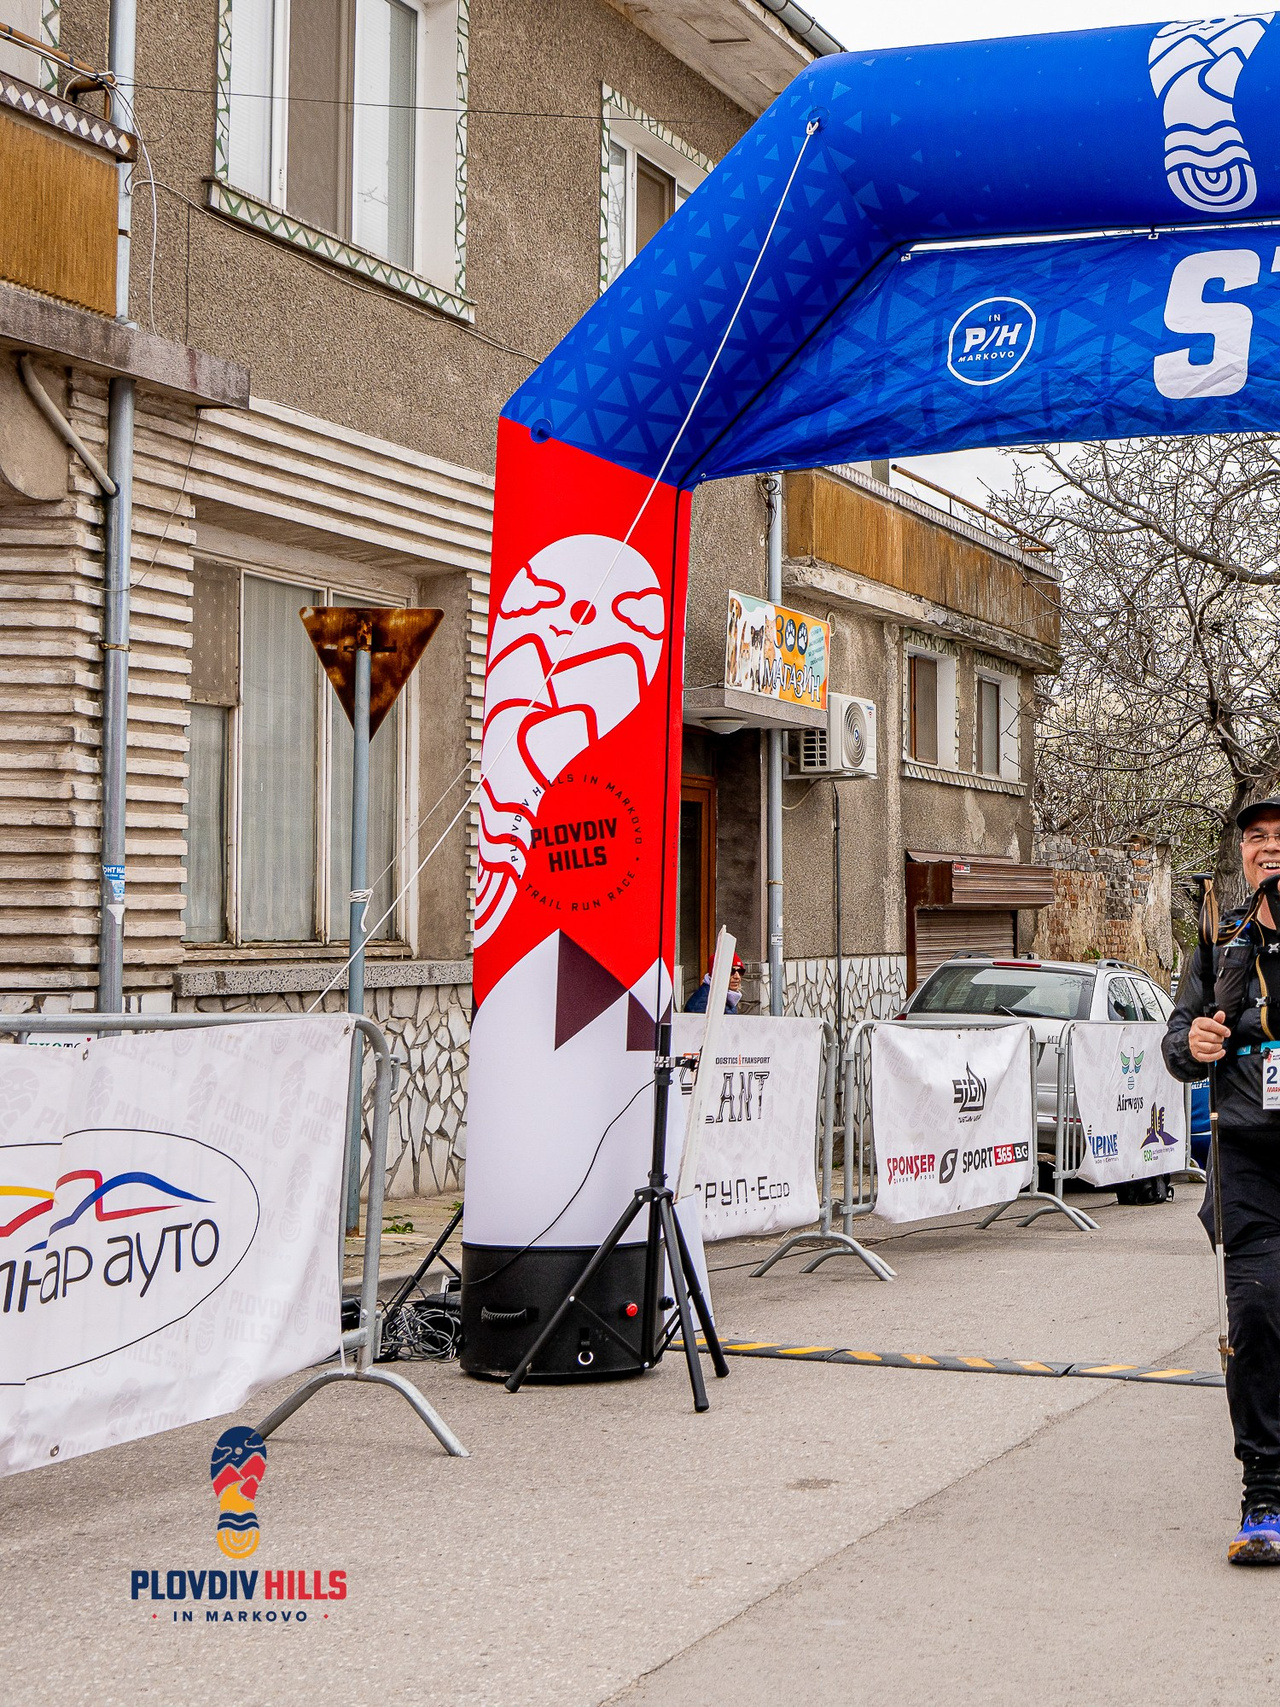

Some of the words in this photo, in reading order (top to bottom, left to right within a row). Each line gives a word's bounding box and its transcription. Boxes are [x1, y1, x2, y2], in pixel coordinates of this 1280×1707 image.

[988, 313, 1001, 322] IN
[957, 350, 1015, 363] MARKOVO
[761, 656, 821, 703] МАГАЗИН
[530, 817, 618, 850] PLOVDIV
[548, 845, 608, 873] HILLS
[525, 883, 562, 911] TRAIL
[571, 899, 601, 912] RUN
[607, 870, 636, 902] RACE
[1116, 1094, 1144, 1114] Airways
[886, 1153, 936, 1186] SPONSER
